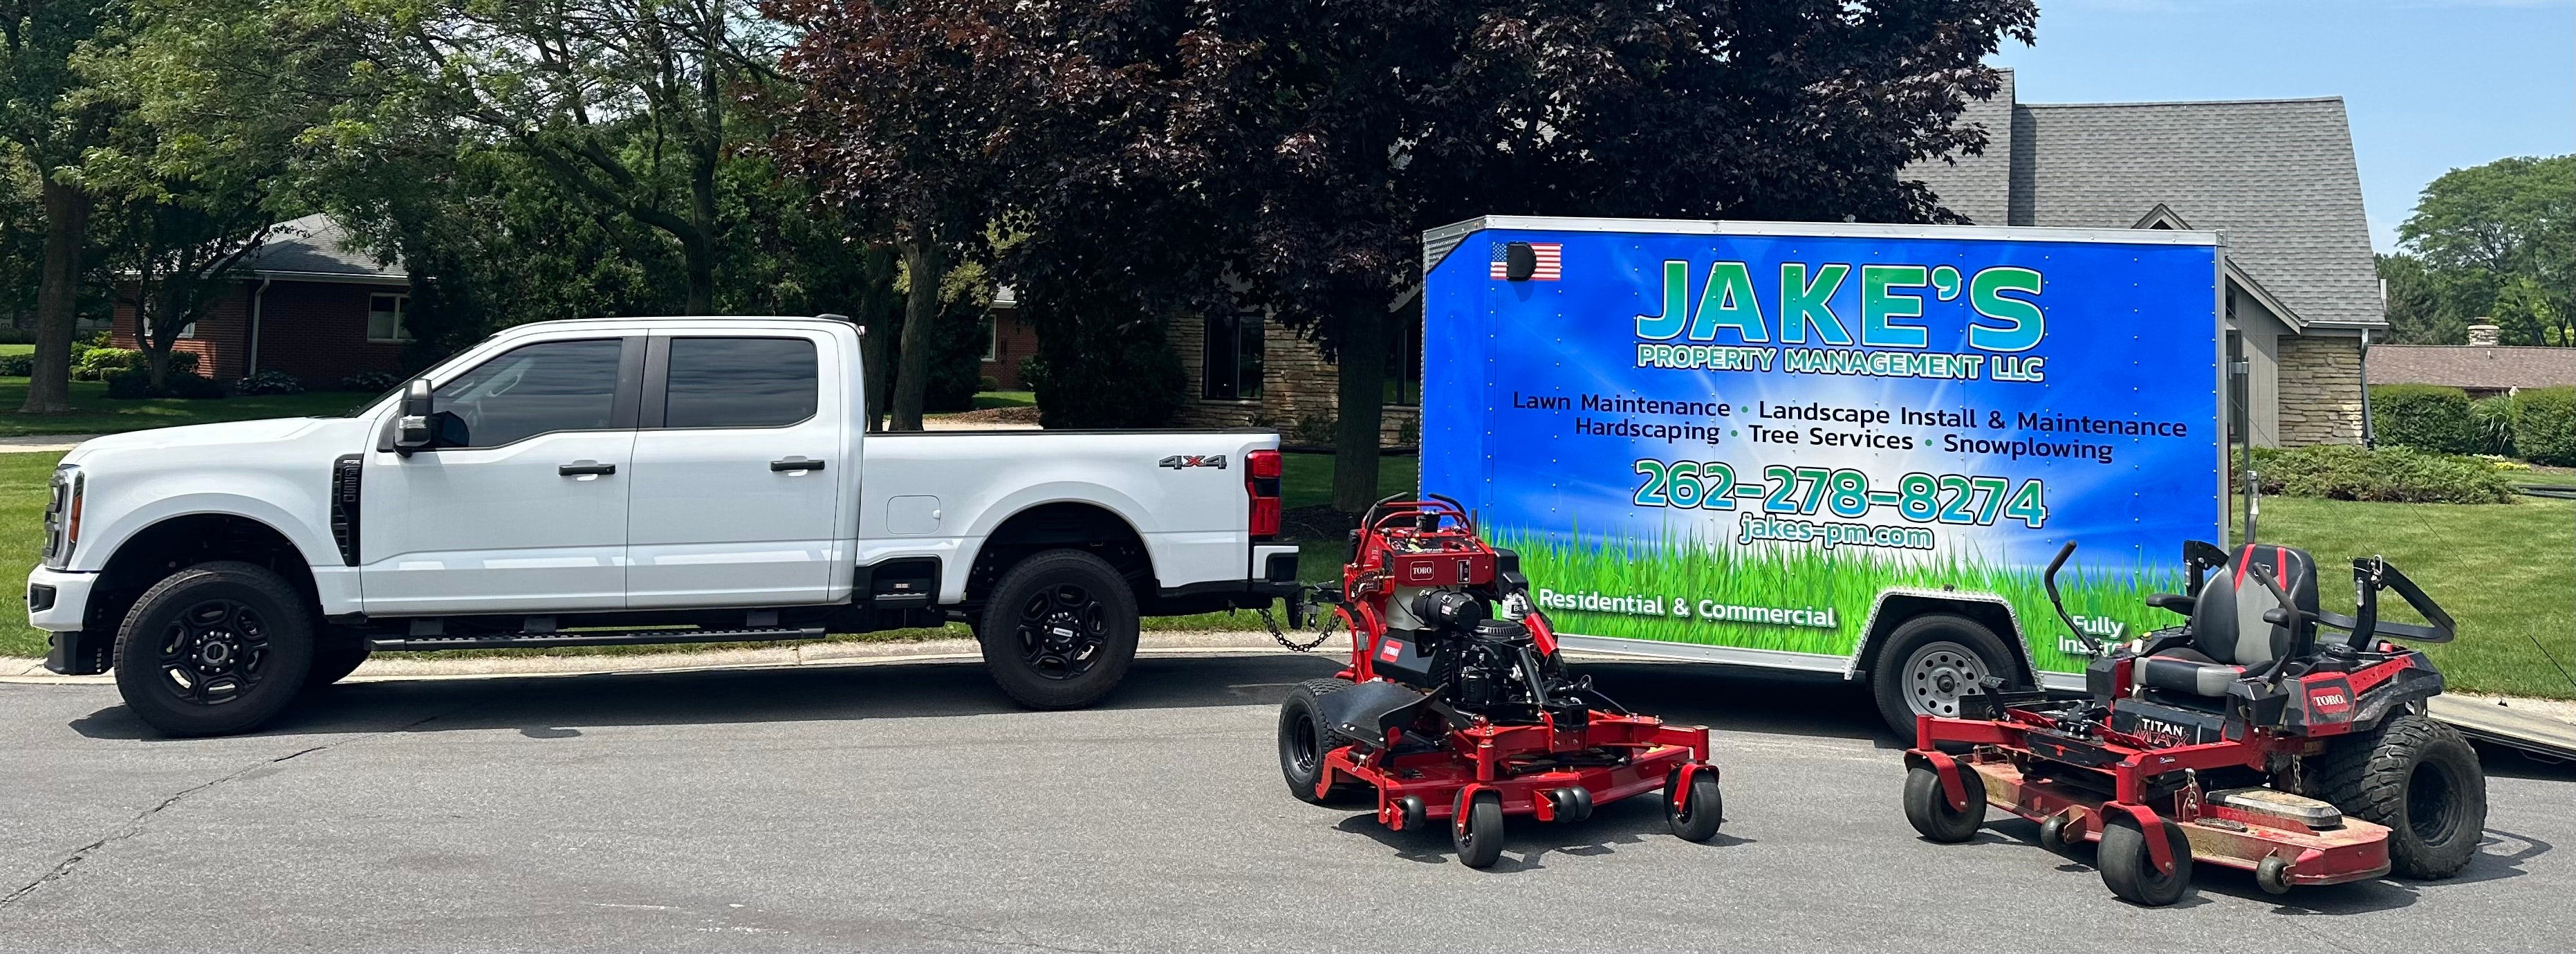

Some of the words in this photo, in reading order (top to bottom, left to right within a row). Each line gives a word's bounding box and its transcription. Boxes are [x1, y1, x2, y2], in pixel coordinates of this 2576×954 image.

[1635, 259, 2046, 351] JAKE'S
[1637, 344, 1776, 372] PROPERTY
[1783, 348, 1984, 380] MANAGEMENT
[1990, 355, 2045, 383] LLC
[1513, 392, 1570, 410] Lawn
[1581, 393, 1731, 417] Maintenance
[1759, 400, 1890, 431] Landscape
[1900, 407, 1977, 428] Install
[1987, 410, 2006, 429] &
[2018, 412, 2187, 437] Maintenance
[1575, 417, 1721, 445] Hardscaping
[1748, 424, 1799, 445] Tree
[1809, 427, 1914, 450] Services
[1944, 433, 2113, 464] Snowplowing
[1633, 459, 2048, 529] 262-278-8274
[1739, 513, 1934, 549] jakes-pm.com
[1413, 567, 1432, 575] TORO
[1539, 588, 1664, 614] Residential
[1673, 597, 1689, 616] &
[1698, 599, 1837, 627] Commercial
[2073, 616, 2124, 637] Fully
[2313, 694, 2344, 706] TORO
[2133, 723, 2189, 747] MAX
[2142, 719, 2183, 736] TITAN
